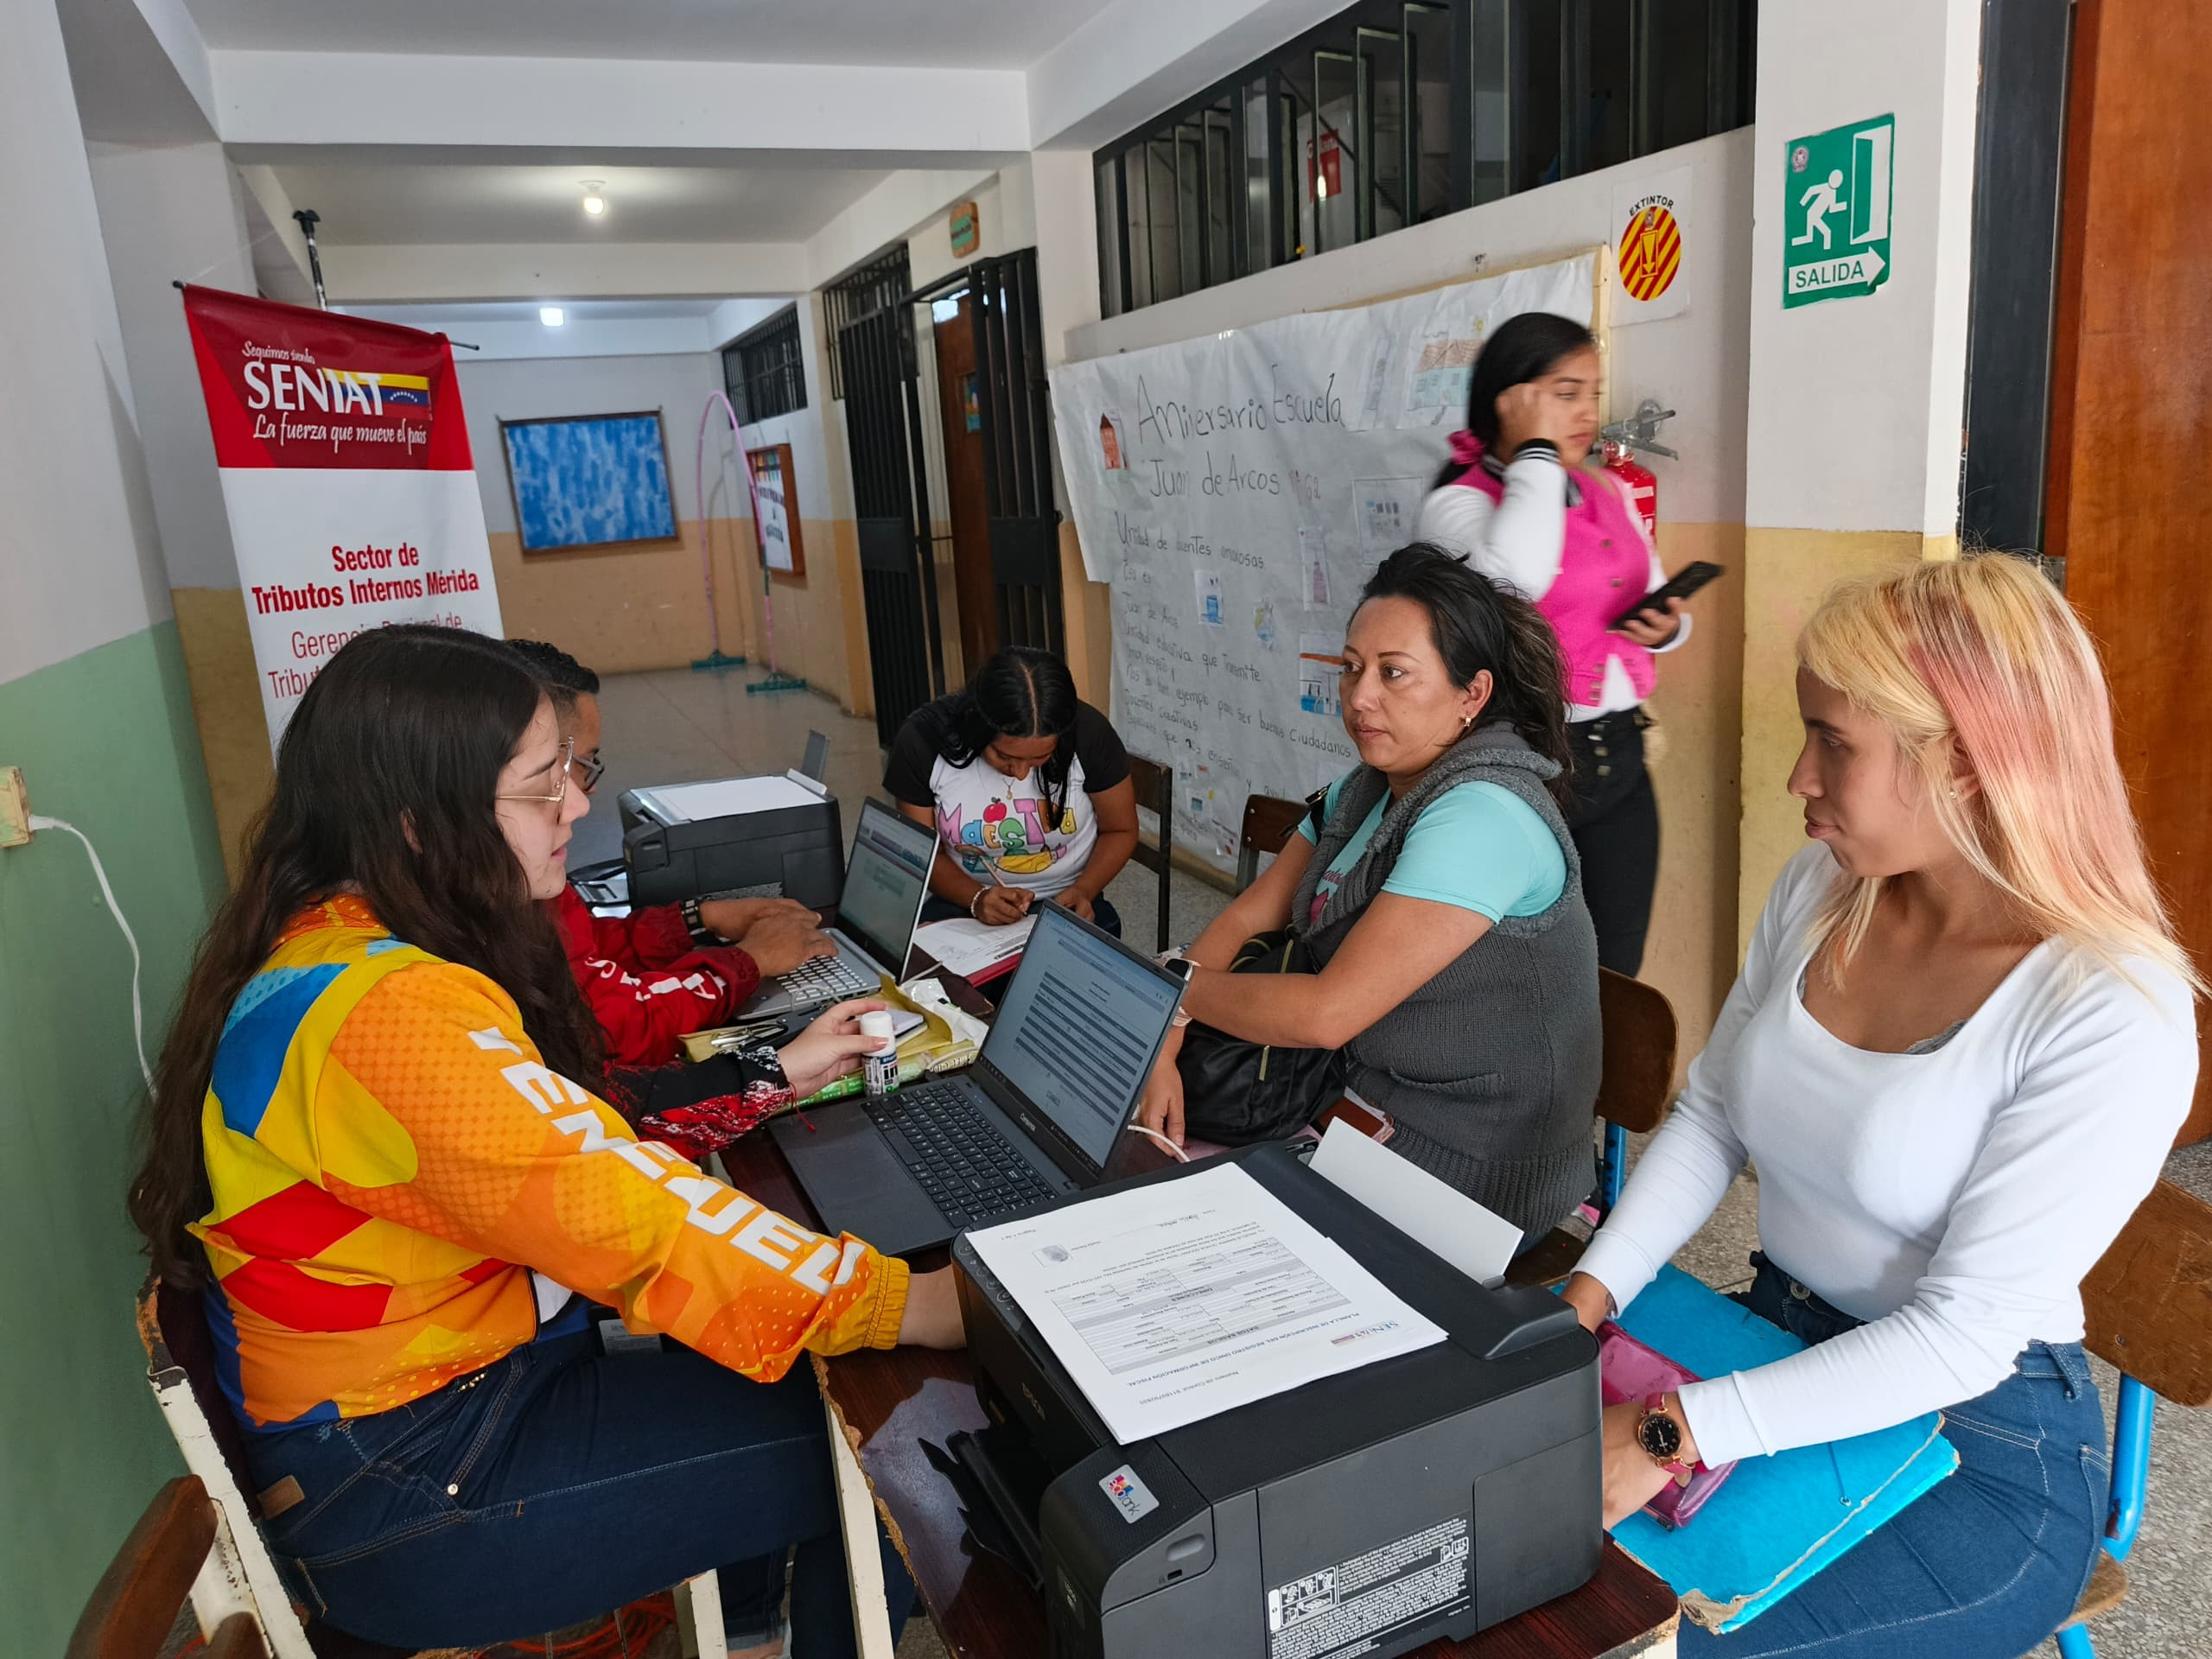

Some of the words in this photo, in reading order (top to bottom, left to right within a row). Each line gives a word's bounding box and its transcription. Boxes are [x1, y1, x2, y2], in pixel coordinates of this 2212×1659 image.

[1630, 194, 1674, 216] EXTINTOR
[1795, 261, 1864, 288] SALIDA
[242, 340, 289, 363] Seguimos
[244, 361, 384, 416] SENIAT
[1271, 364, 1345, 429] Escuela
[253, 414, 276, 438] La
[280, 412, 327, 446] fuerza
[331, 425, 353, 454] que
[356, 426, 394, 442] mueve
[397, 418, 406, 443] el
[1203, 451, 1224, 496] de
[1229, 454, 1279, 494] Arcos
[332, 544, 392, 572] Sector
[398, 543, 419, 567] de
[251, 582, 344, 614] Tributos
[349, 576, 423, 604] Internos
[426, 569, 479, 596] Mérida
[291, 624, 364, 658] Geren
